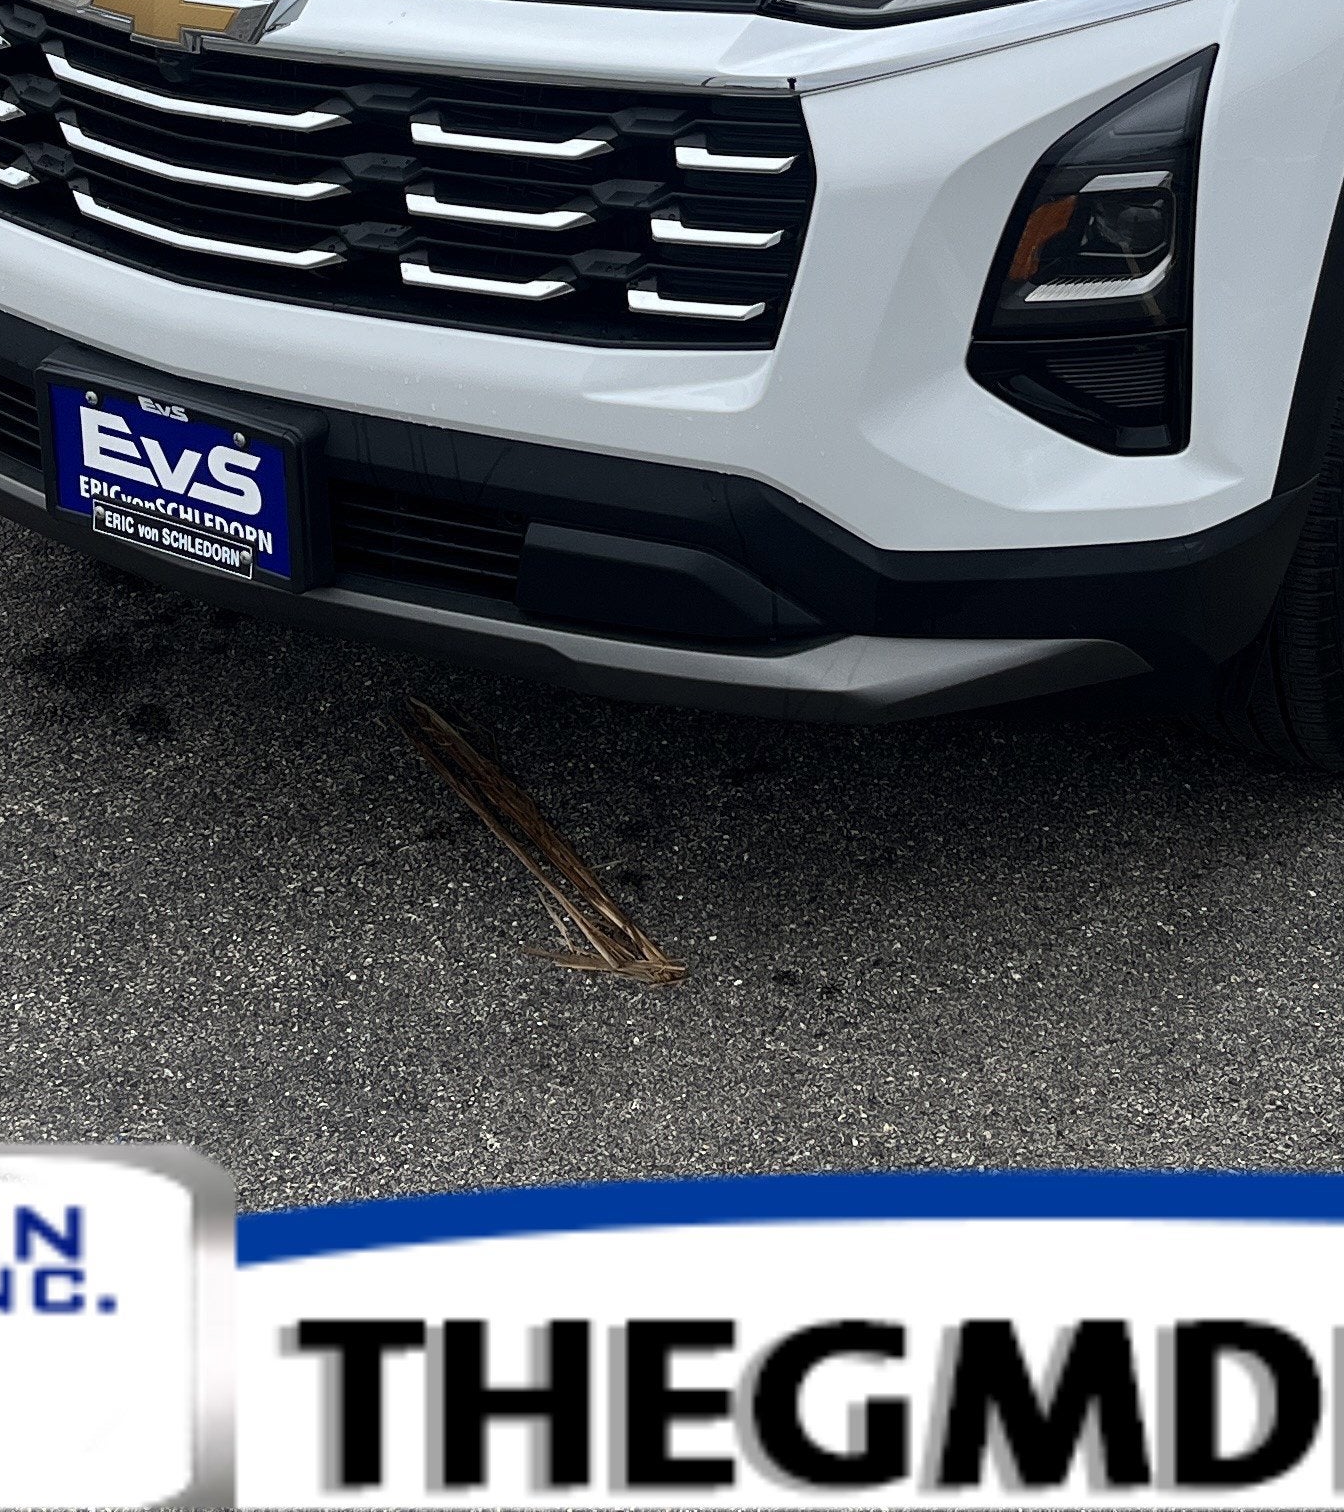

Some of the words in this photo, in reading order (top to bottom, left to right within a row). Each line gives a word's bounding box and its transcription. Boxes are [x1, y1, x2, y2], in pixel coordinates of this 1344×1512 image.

[105, 511, 135, 534] ERIC
[138, 523, 159, 542] von
[162, 527, 241, 568] SCHLEDORN
